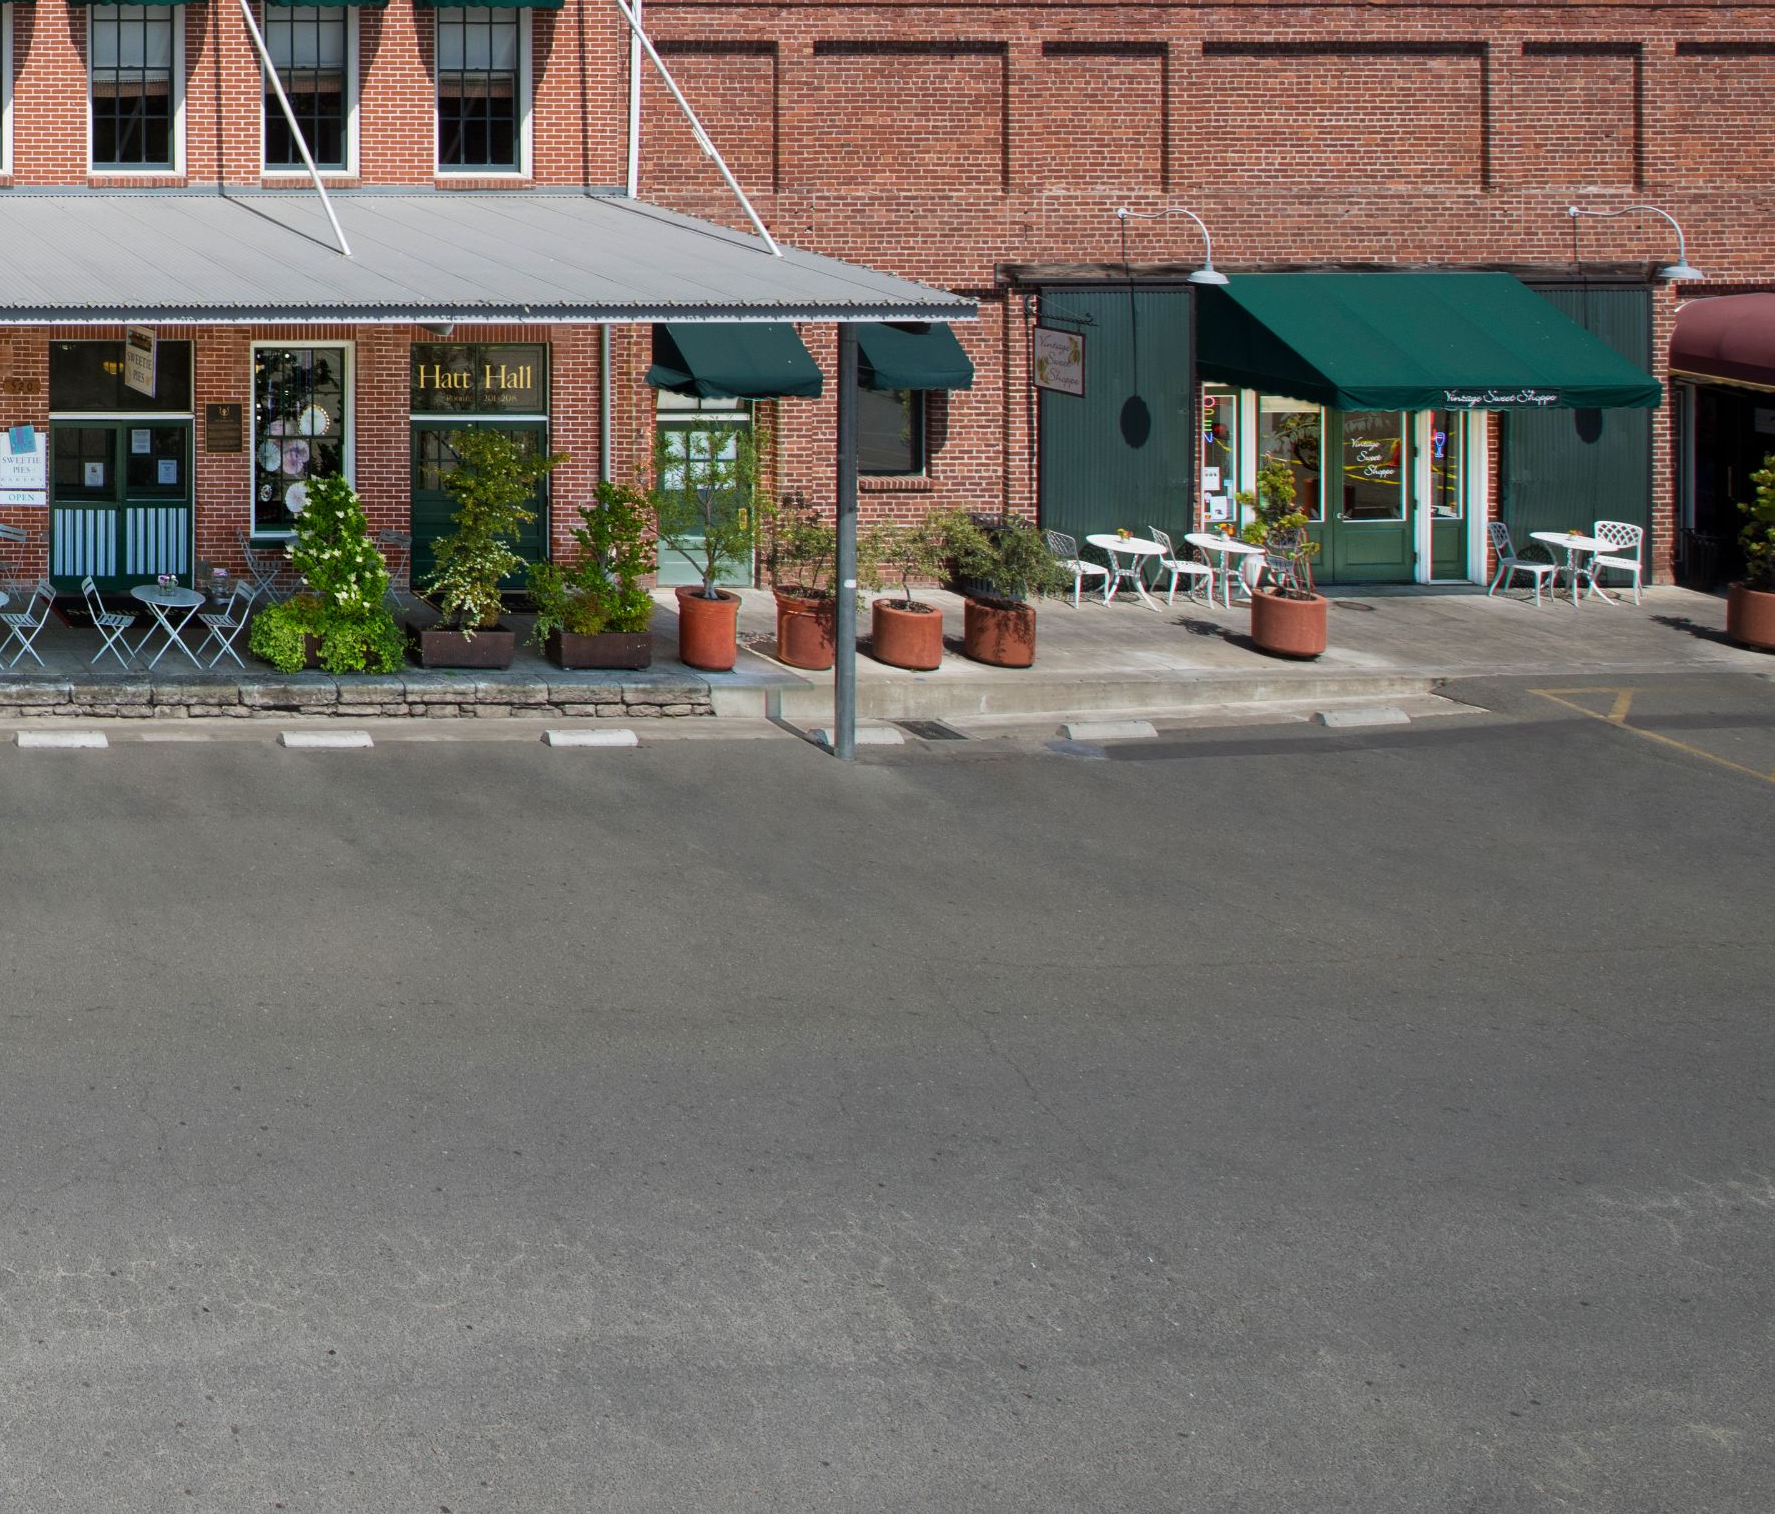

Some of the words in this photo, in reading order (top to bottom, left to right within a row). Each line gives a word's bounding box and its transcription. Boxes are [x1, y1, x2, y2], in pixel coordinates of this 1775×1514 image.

[1039, 334, 1070, 354] Vintage
[127, 351, 152, 370] SWEETIE
[1047, 351, 1072, 367] Sweet
[133, 369, 145, 384] PIES
[418, 364, 472, 389] Hatt
[484, 364, 532, 389] Hall
[1048, 367, 1079, 389] Shoppe
[11, 382, 34, 391] 520
[1443, 389, 1483, 407] Vintage
[1483, 389, 1516, 403] Sweet
[1516, 389, 1557, 406] Shoppe
[1350, 436, 1381, 451] Vintage
[2, 456, 41, 464] SWEETIE
[1356, 450, 1382, 462] Sweet
[13, 466, 31, 474] PIES
[1363, 464, 1395, 478] Shoppe
[8, 493, 35, 501] OPEN
